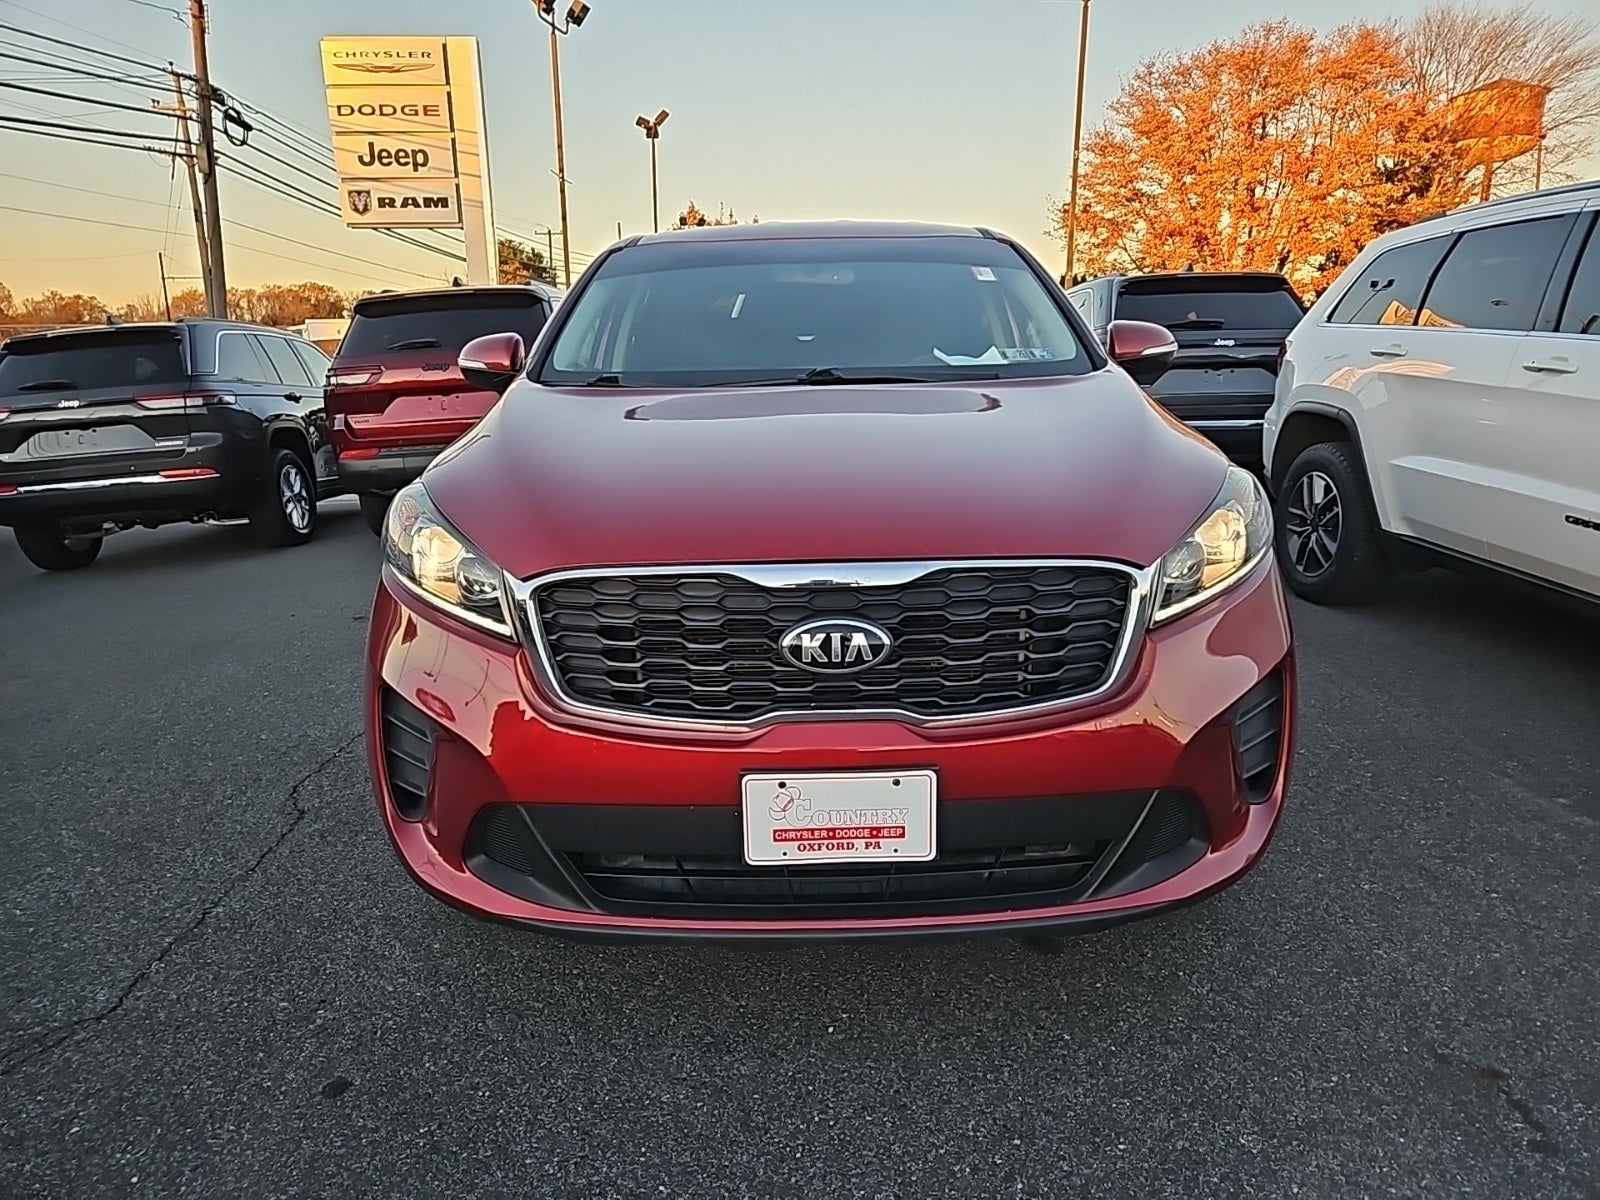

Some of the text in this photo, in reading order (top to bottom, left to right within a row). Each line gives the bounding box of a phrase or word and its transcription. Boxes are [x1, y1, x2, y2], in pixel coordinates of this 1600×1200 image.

[333, 50, 432, 59] CHRYSLER
[336, 104, 441, 117] DODGE
[357, 142, 430, 172] Jeep
[377, 196, 449, 209] RAM
[1214, 338, 1235, 346] Jeep
[58, 399, 80, 408] Jeep
[800, 632, 873, 662] KIA
[785, 798, 909, 827] COUNTRY
[774, 828, 903, 840] CHRYSLER DODGE JEEP
[797, 841, 882, 852] OXFORD, PA
